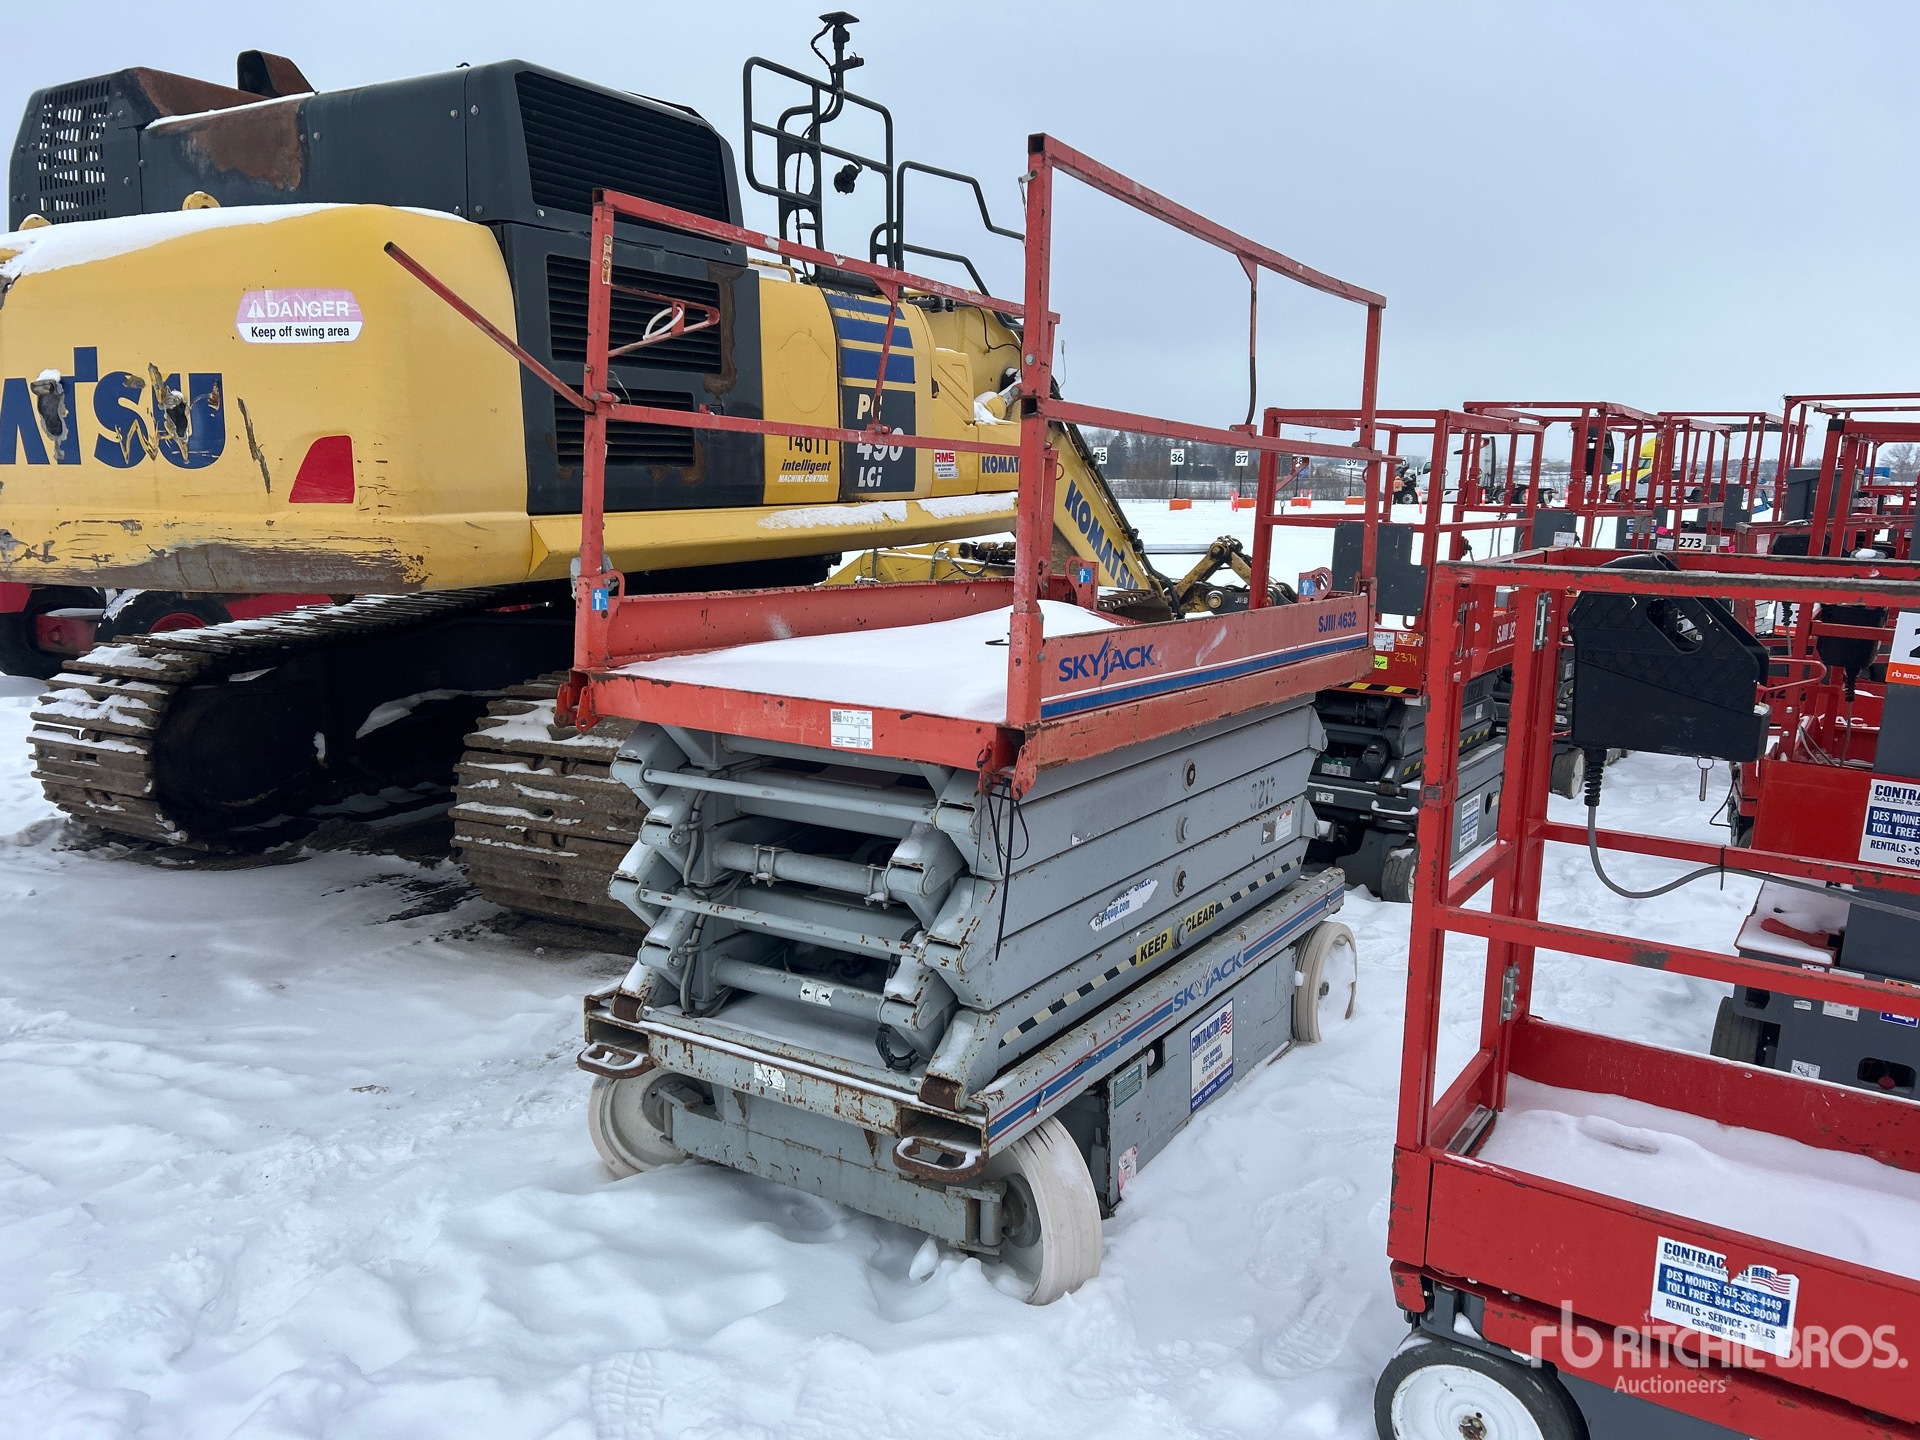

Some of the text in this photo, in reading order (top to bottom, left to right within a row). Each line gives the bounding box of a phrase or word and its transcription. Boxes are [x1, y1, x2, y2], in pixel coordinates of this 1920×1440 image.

[266, 300, 349, 318] DANGER
[251, 325, 349, 340] Keep off swing area
[934, 452, 955, 463] RMS
[1171, 453, 1183, 462] 36
[1235, 455, 1248, 464] 37
[781, 459, 832, 474] intelligent
[778, 474, 829, 483] MACHINE CONTROL
[1679, 537, 1701, 548] 273
[1338, 611, 1357, 629] 4632
[1058, 636, 1155, 682] SKYJACK
[1394, 652, 1417, 666] 2374
[1874, 784, 1920, 801] CONTR
[1874, 795, 1905, 805] SALES
[1873, 810, 1890, 822] DES
[1872, 822, 1920, 839] TOLL FREE:
[1870, 839, 1907, 853] RENTALS
[1140, 903, 1215, 962] KEEP CLEAR
[1173, 950, 1243, 1013] SKYJACK
[1667, 1268, 1782, 1310] DES MOINES: 515-266-4449
[1666, 1281, 1781, 1324] TOLL FREE: 844-CSS-BOOM
[1665, 1298, 1776, 1339] RENTALS SERVICE SALES
[1691, 1317, 1746, 1340] cssequip.com
